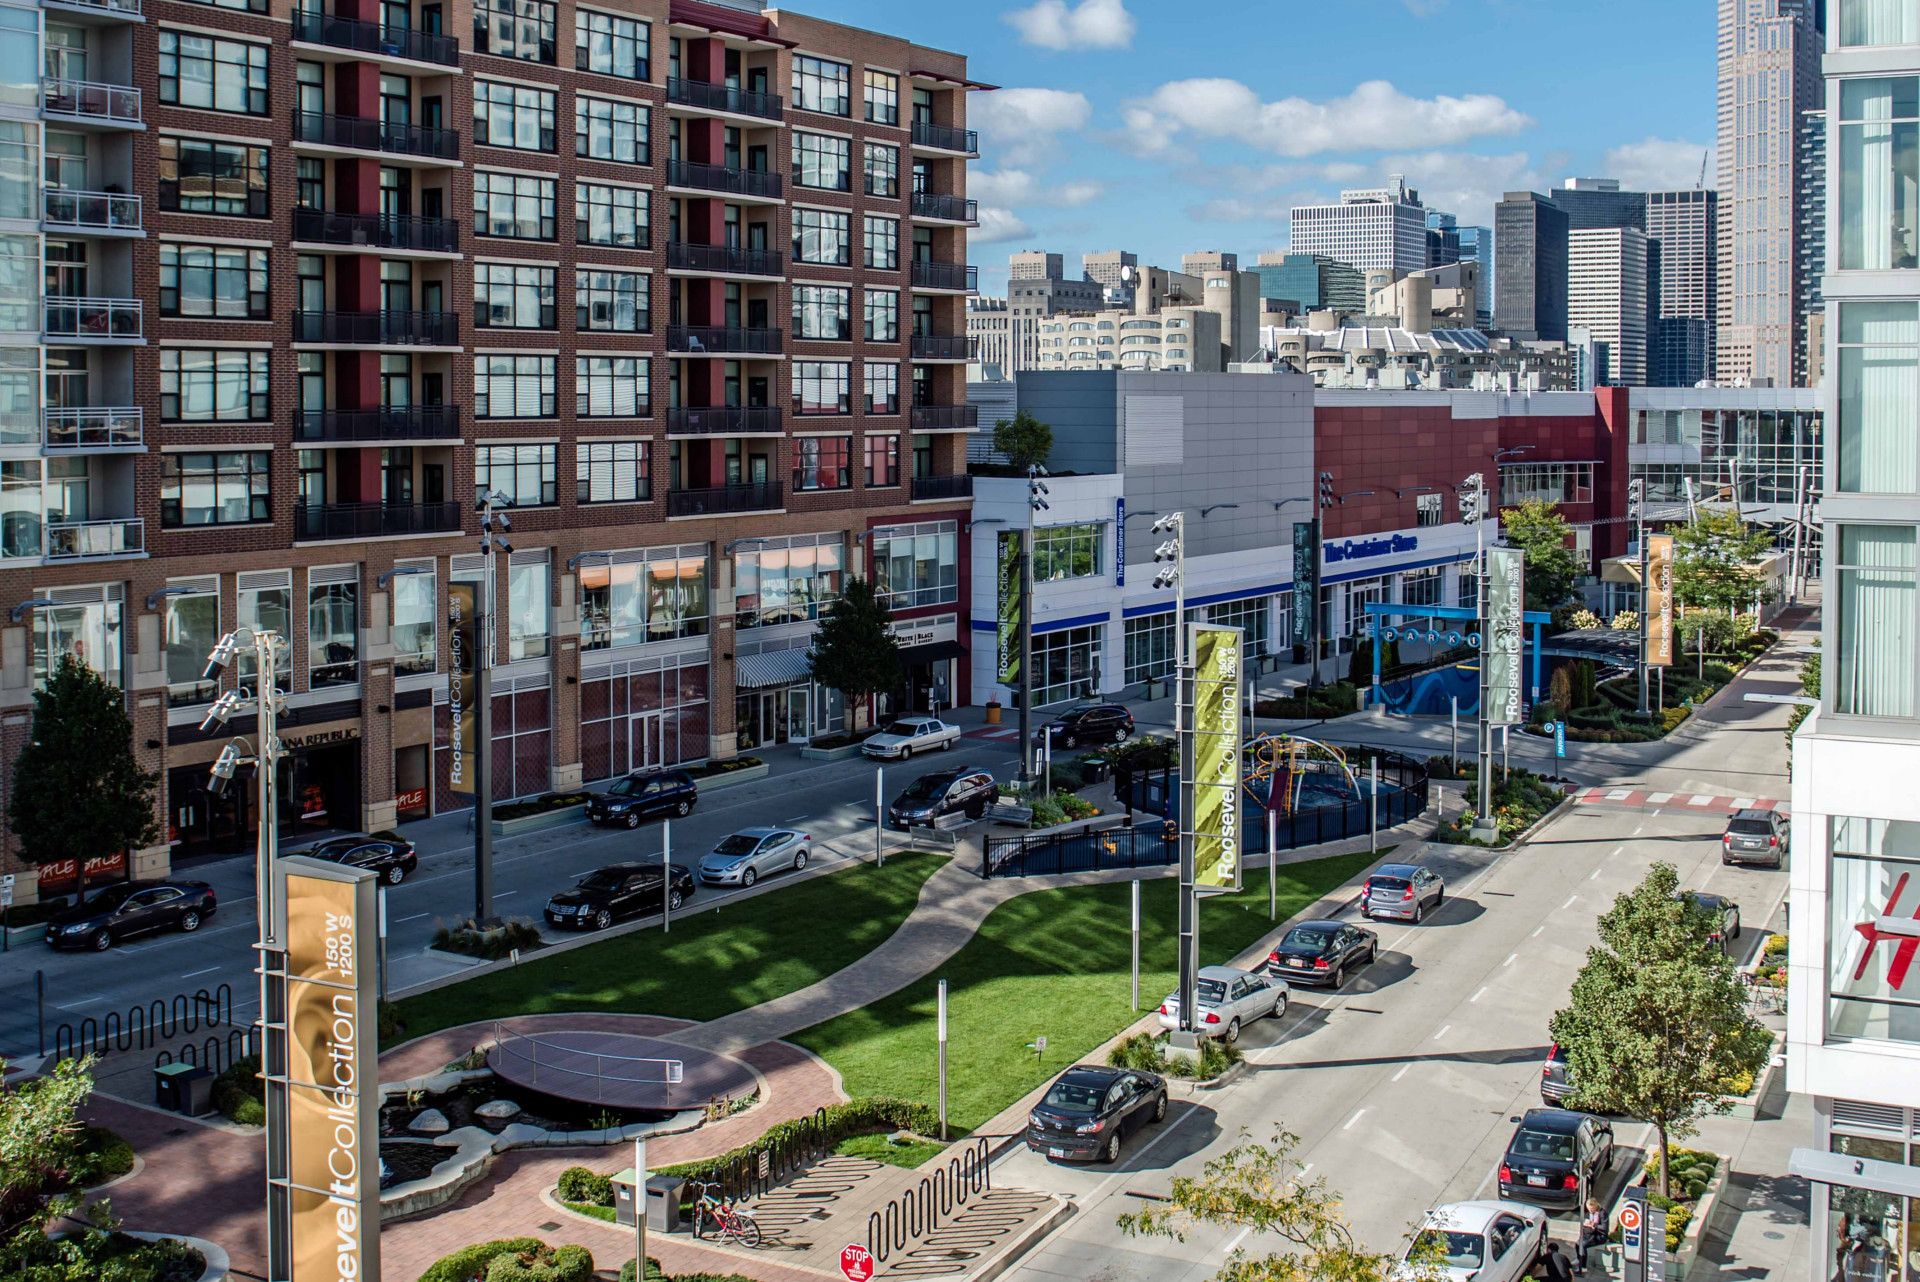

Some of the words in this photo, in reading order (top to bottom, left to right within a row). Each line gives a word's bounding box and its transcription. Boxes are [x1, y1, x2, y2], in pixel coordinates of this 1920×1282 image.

[1323, 542, 1344, 563] The
[1344, 537, 1392, 560] Container
[1392, 533, 1418, 553] Store
[998, 564, 1009, 677] RooseveltCollection
[1386, 631, 1476, 645] PARKI
[1505, 586, 1520, 716] RooseveltCollection
[1218, 657, 1227, 676] 150
[1228, 657, 1236, 678] 1200
[450, 628, 462, 785] RooseveltCollection
[306, 728, 358, 746] REPUBLIC
[1217, 685, 1236, 879] RooseveltCollection
[324, 911, 339, 932] W
[339, 914, 352, 930] S
[326, 937, 338, 969] 150
[339, 932, 352, 978] 1200
[327, 994, 357, 1282] eveltCollection
[1624, 1212, 1635, 1224] P
[845, 1248, 869, 1262] STOP
